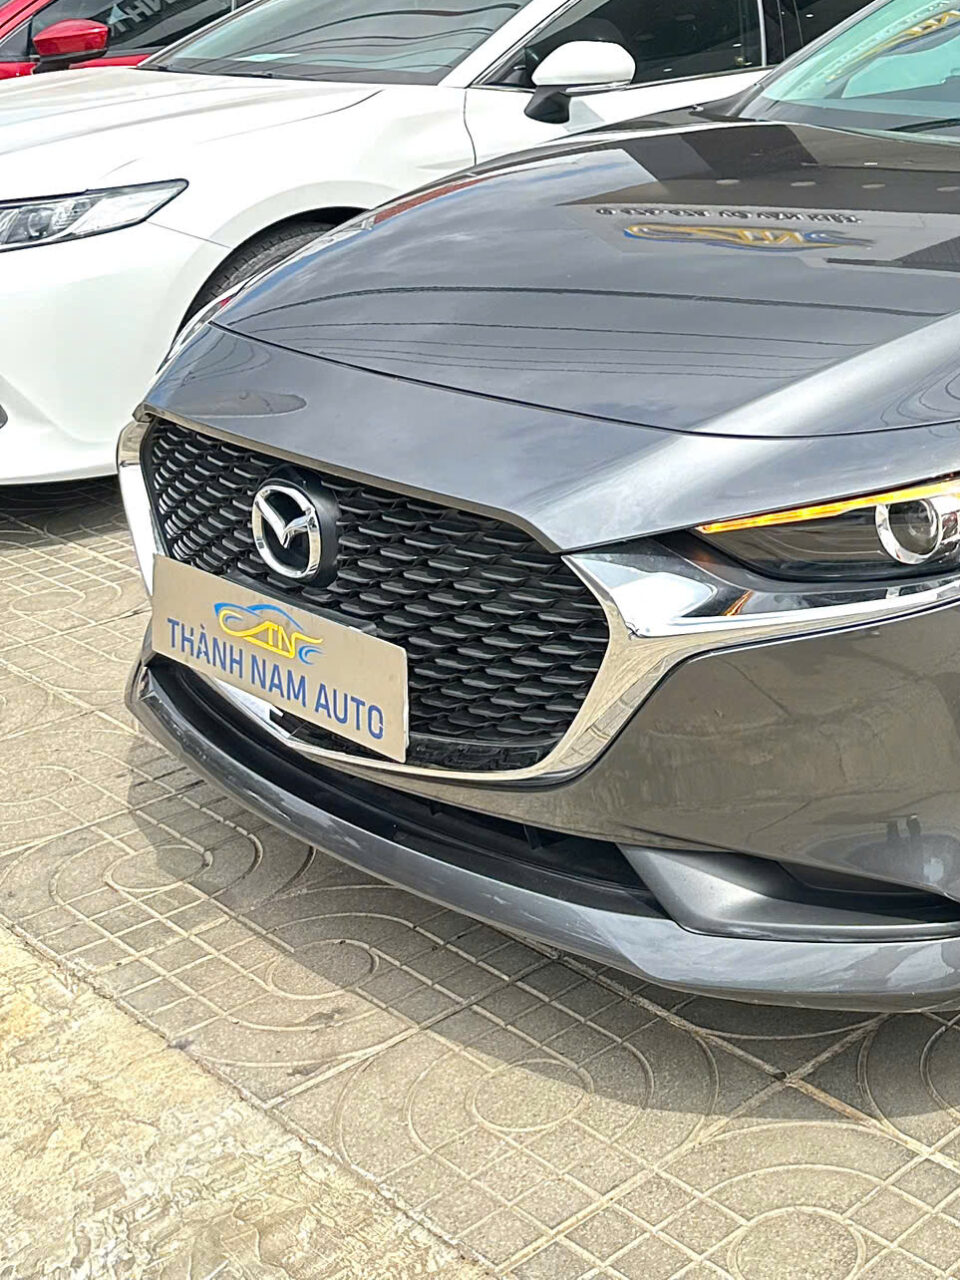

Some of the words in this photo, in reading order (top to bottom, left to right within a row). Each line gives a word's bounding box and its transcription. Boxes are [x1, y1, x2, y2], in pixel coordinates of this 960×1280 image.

[167, 617, 243, 679] THÀNH
[251, 654, 306, 707] NAM
[314, 683, 384, 740] AUTO
